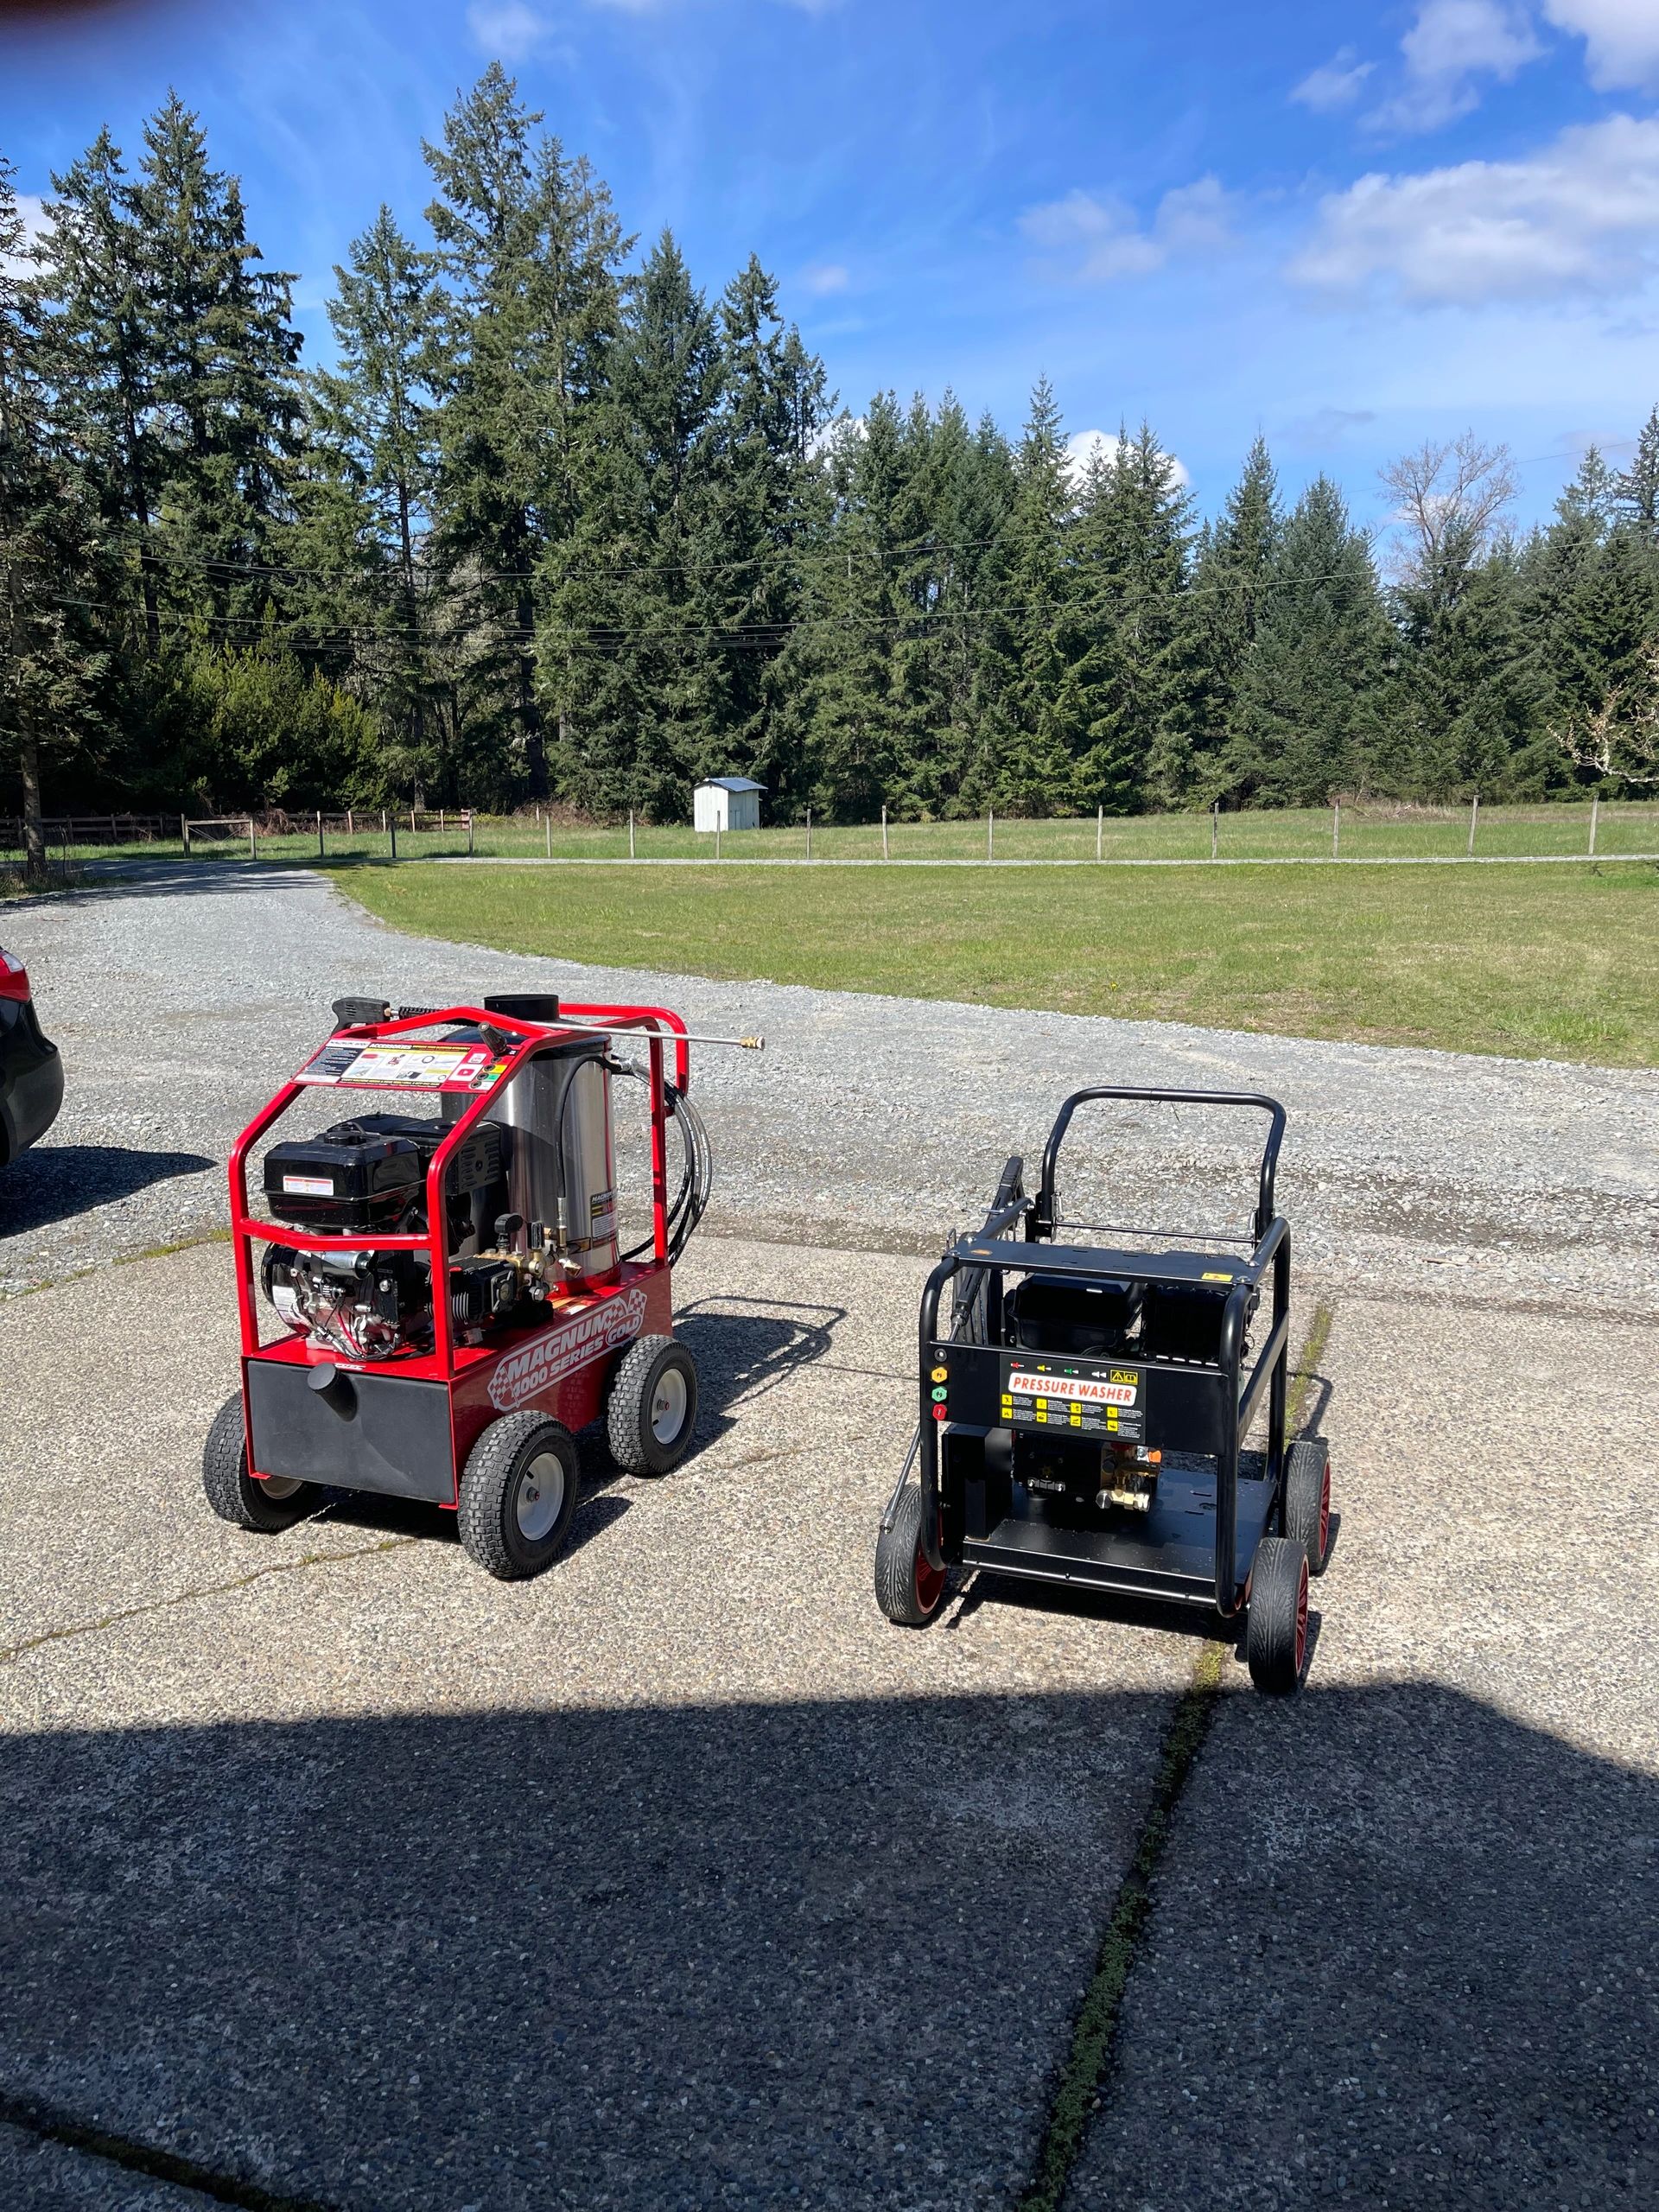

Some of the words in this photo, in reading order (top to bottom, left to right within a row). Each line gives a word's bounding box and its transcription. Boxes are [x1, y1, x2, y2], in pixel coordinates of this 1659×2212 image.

[508, 1310, 613, 1382] MAGNUM
[607, 1315, 640, 1344] GOLD
[512, 1367, 548, 1397] 4000
[550, 1335, 604, 1377] SERIES
[1014, 1376, 1076, 1395] PRESSURE
[1079, 1384, 1132, 1402] WASHER
